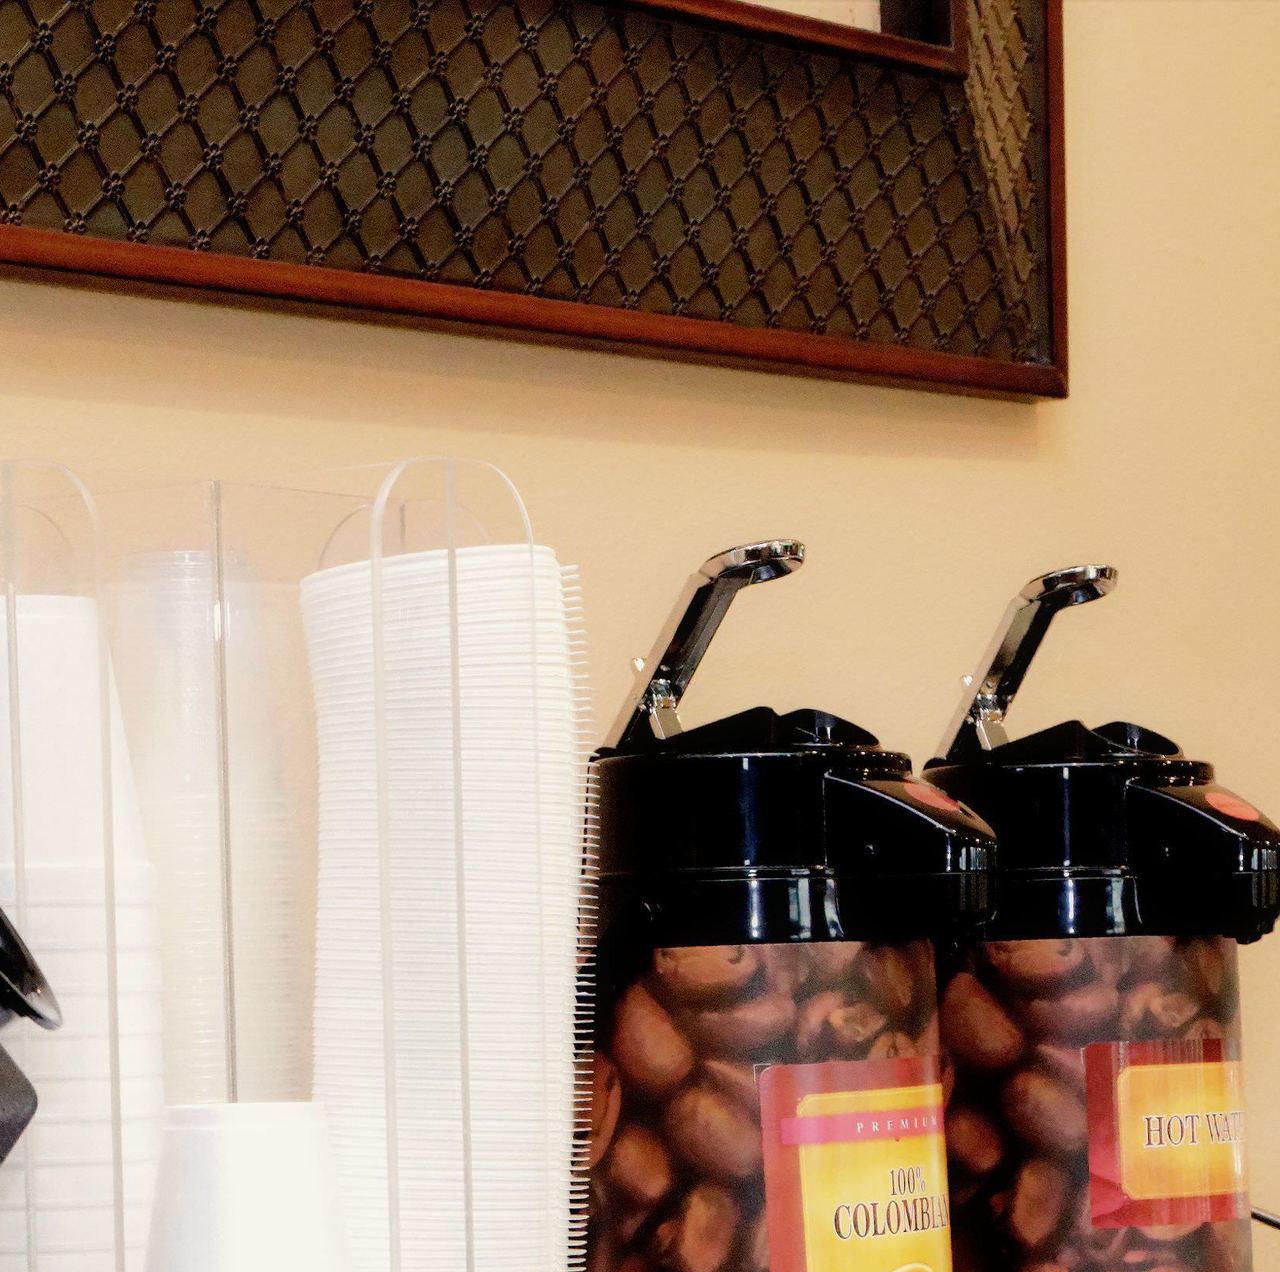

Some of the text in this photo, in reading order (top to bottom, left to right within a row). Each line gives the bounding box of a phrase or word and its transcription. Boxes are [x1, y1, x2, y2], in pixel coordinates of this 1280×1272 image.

[856, 1115, 937, 1133] PREMIUM
[1143, 1114, 1200, 1147] HOT
[889, 1166, 926, 1196] 100%
